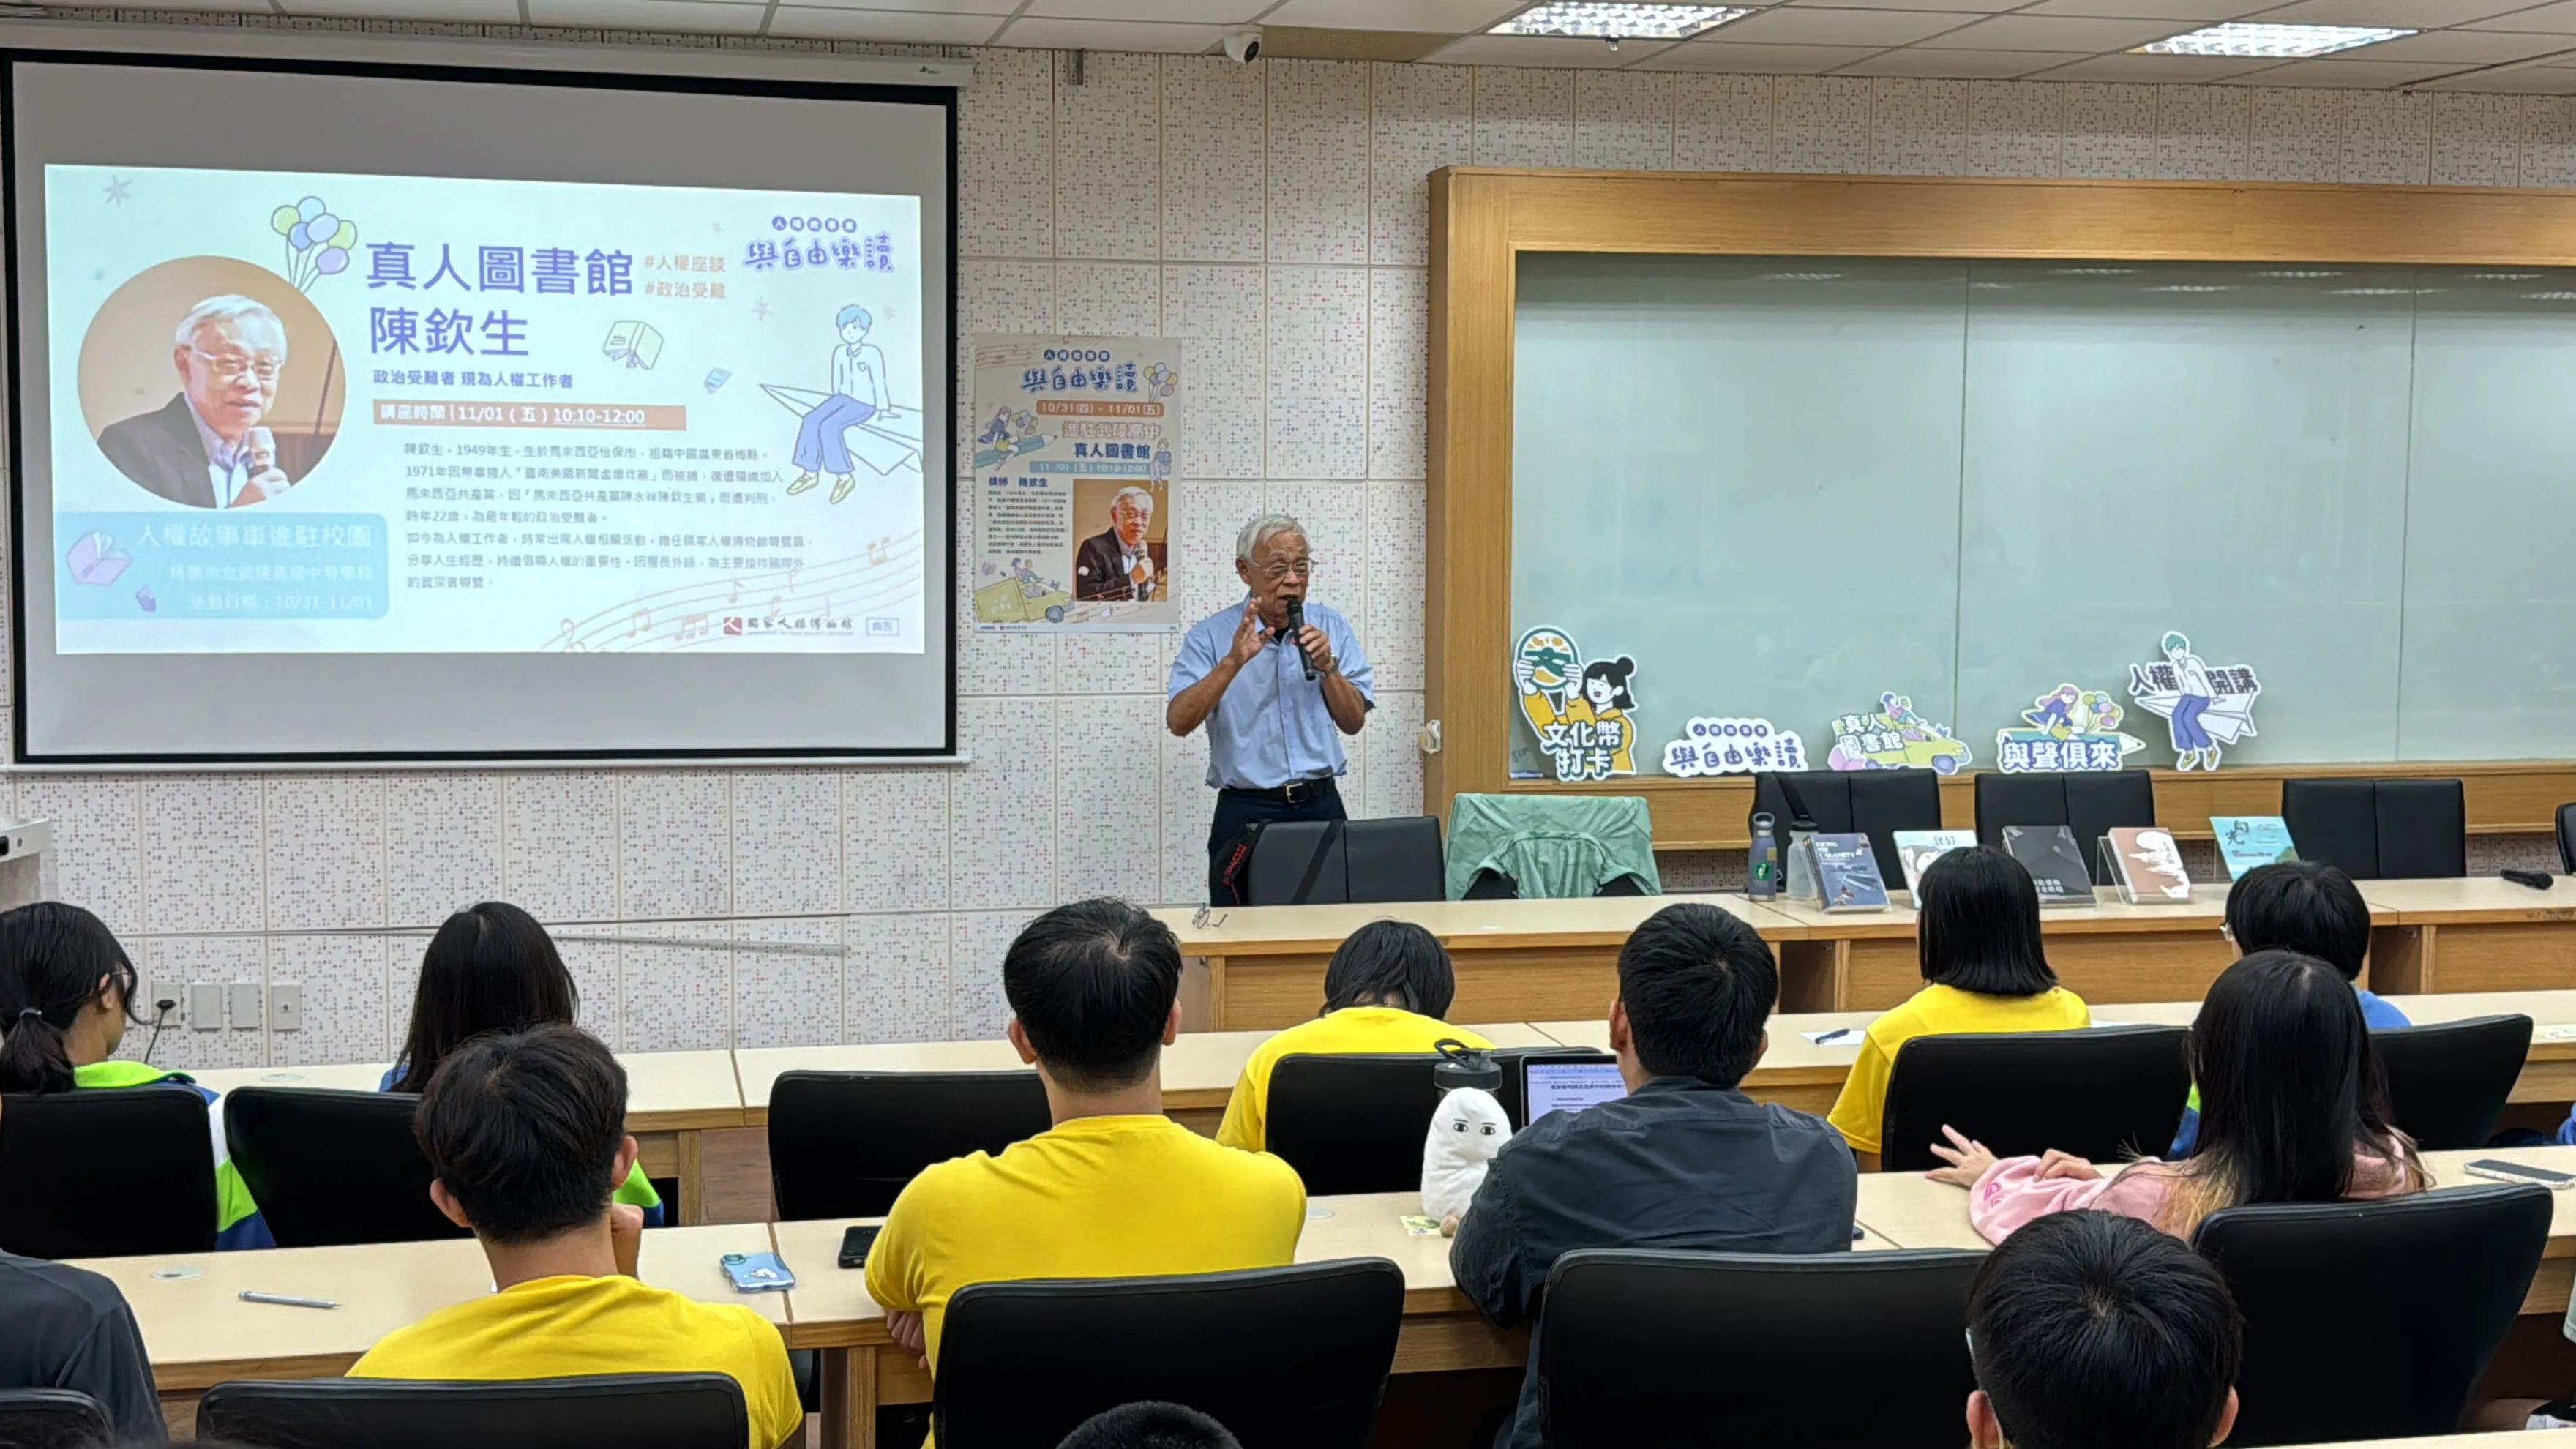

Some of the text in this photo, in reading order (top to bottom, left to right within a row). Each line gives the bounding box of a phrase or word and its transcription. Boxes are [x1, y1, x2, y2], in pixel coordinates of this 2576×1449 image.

[645, 255, 726, 272] #人權座談
[743, 233, 894, 272] 與自由樂讀
[366, 242, 633, 296] 真人圖書館
[645, 282, 726, 299] #政治受難
[370, 307, 529, 356] 陳欽生
[373, 368, 574, 389] 政治受難者 現為人權工作者
[1021, 362, 1137, 394] 與自由樂讀
[553, 409, 645, 424] 10:10-12:00
[1074, 443, 1151, 459] 真人圖書館
[2133, 663, 2256, 694] 人權 開講
[1543, 721, 1621, 748] 文化幣
[1841, 713, 1887, 733] 真人
[1559, 747, 1611, 774] 打卡
[1670, 737, 1802, 770] 與自由樂讀
[2002, 740, 2119, 770] 與聲俱來
